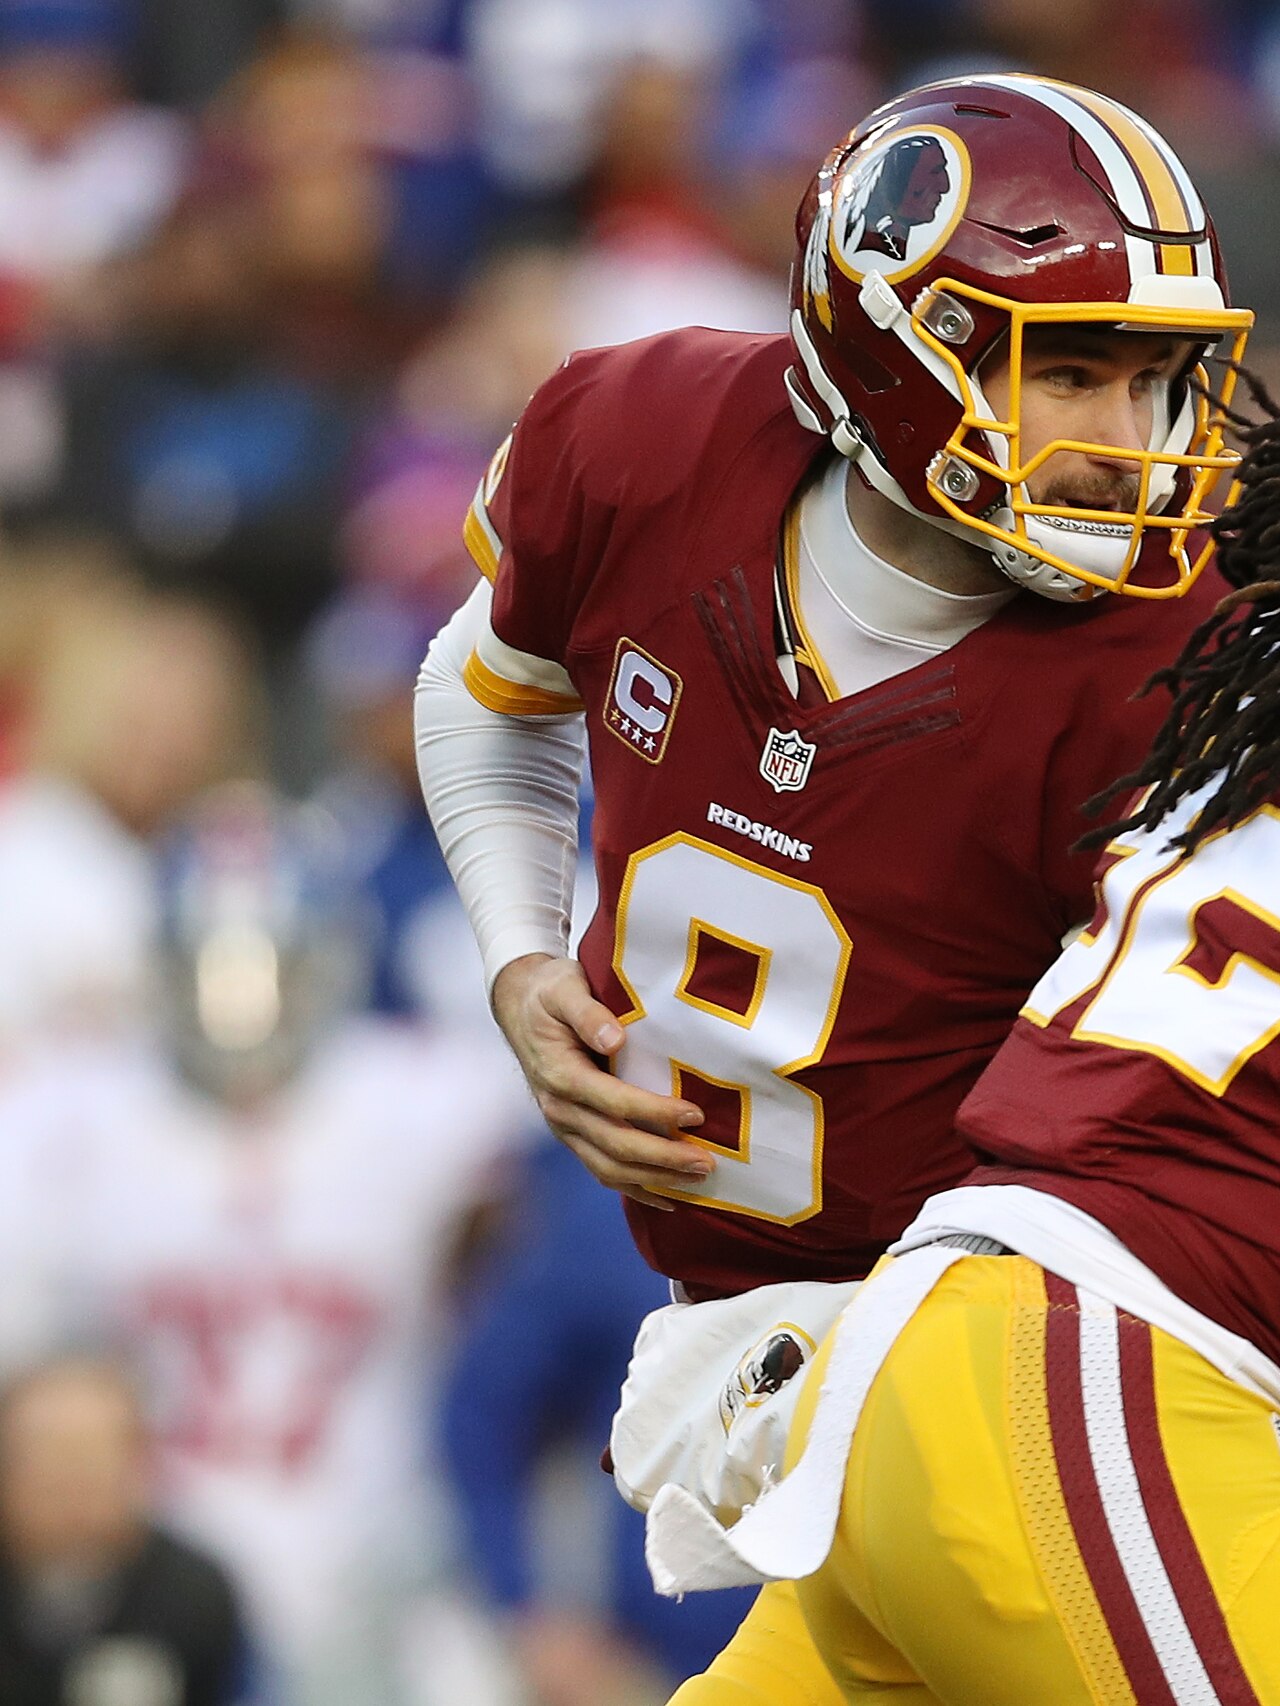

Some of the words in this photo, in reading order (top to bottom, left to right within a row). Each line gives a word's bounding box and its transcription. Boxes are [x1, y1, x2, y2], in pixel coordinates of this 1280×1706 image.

[614, 651, 673, 733] C
[767, 752, 800, 783] NFL
[707, 802, 813, 862] REDSKINS
[611, 830, 853, 1228] 8
